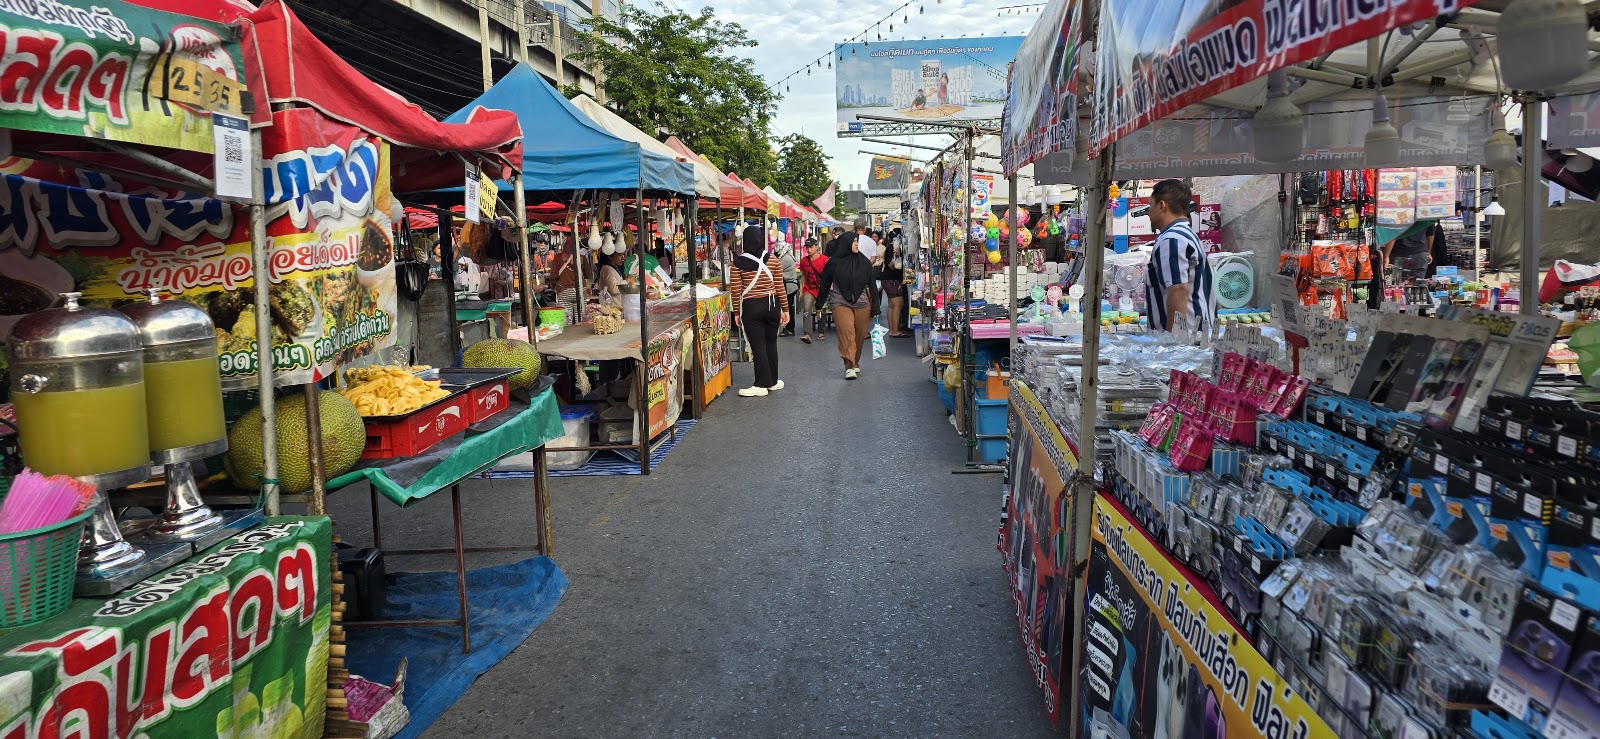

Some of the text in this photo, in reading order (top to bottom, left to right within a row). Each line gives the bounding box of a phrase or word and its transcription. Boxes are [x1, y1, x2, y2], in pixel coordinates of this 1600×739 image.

[1152, 17, 1257, 103] ฟิลมไอแพด
[0, 30, 130, 122] สดๆ
[210, 80, 230, 110] 35
[892, 80, 915, 94] GOOD
[120, 230, 361, 290] น้ำจิ้มอ่อยเด็ด!!
[1482, 414, 1501, 428] FOCUS
[1527, 429, 1551, 443] FOCUS
[1413, 446, 1431, 461] FOCUS
[1450, 462, 1470, 479] FOCUS
[1495, 482, 1518, 499] FOCUS
[1554, 504, 1584, 525] FOCUS
[1523, 587, 1550, 608] FOCUS
[1164, 580, 1250, 712] ฟิล์มกันเสือก
